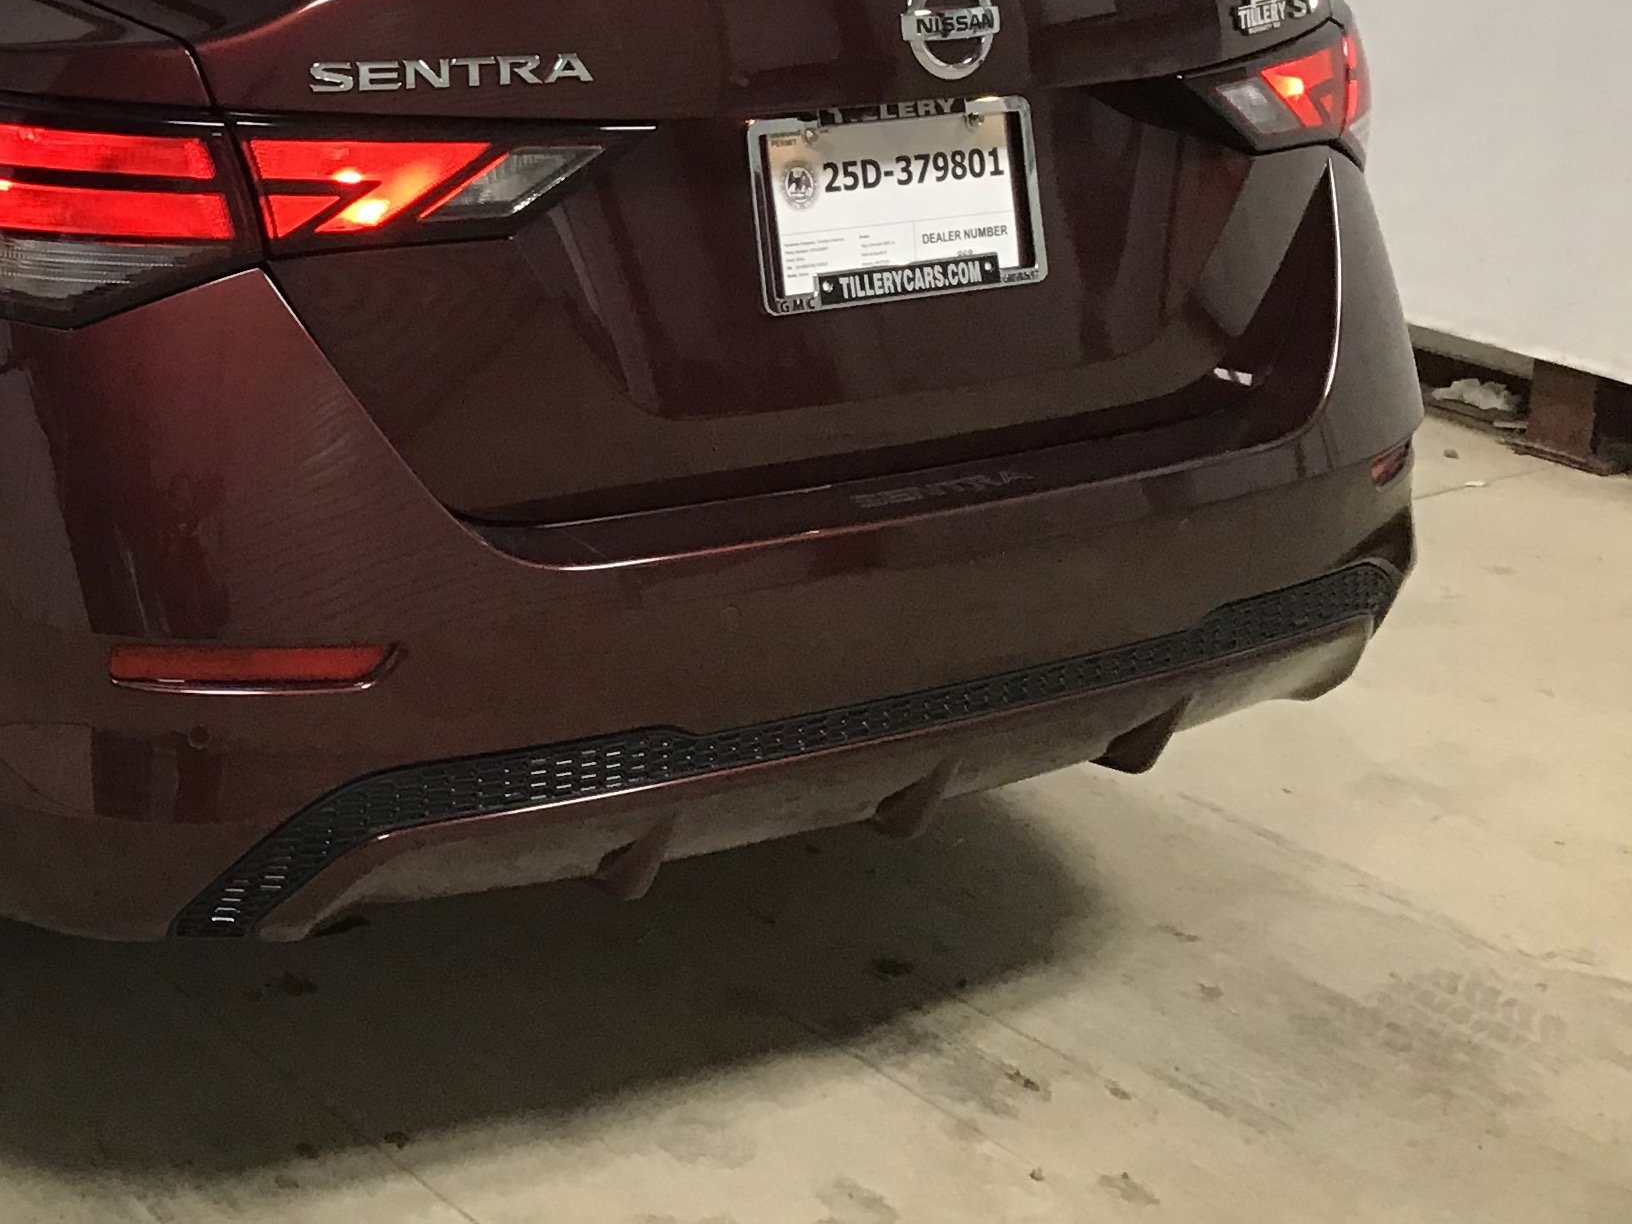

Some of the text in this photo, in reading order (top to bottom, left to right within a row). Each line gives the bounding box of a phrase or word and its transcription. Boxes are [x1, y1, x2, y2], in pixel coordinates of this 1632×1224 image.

[915, 8, 995, 34] NISSAN
[1237, 0, 1286, 30] TILLERY
[309, 52, 595, 93] SENTRA
[822, 146, 1005, 193] 25D-379801
[921, 224, 1009, 245] DEALER NUMBER
[838, 260, 983, 300] TILLERYCARS.COM
[779, 297, 816, 314] GMC
